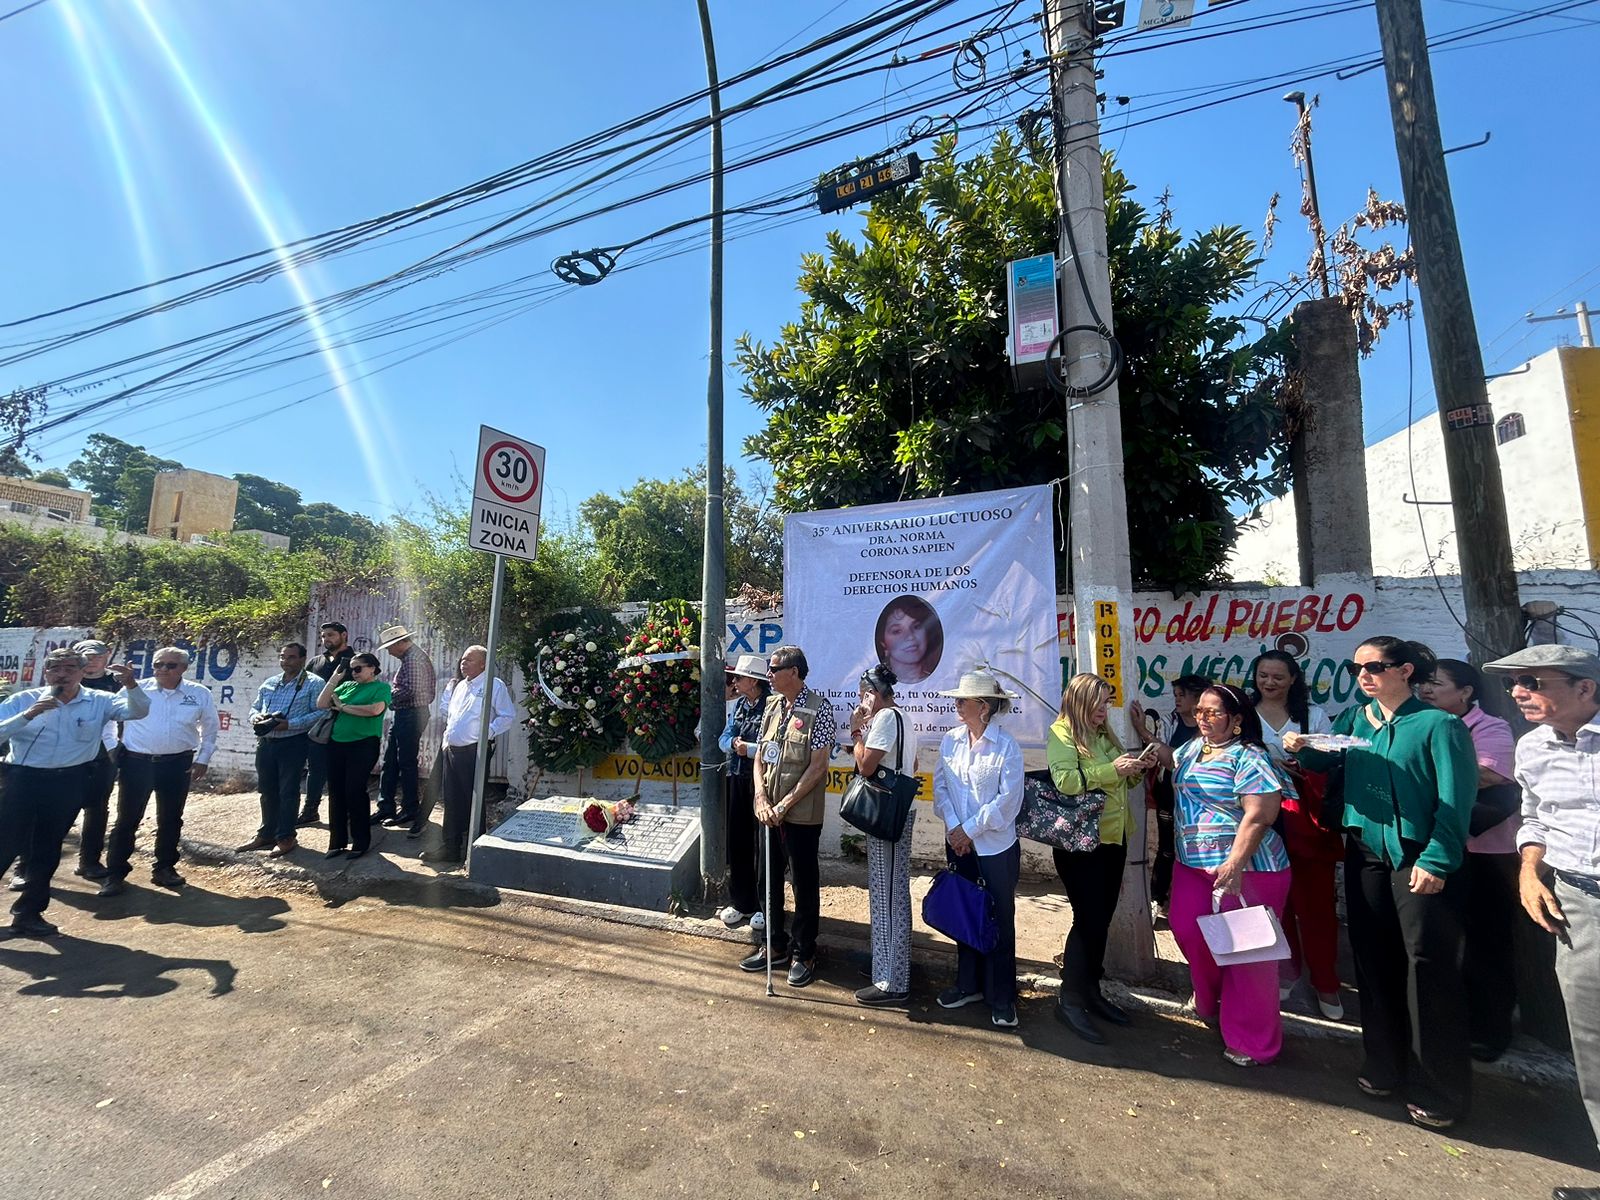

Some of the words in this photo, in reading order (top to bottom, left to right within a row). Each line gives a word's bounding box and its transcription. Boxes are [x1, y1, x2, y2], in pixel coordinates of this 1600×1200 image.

[880, 170, 891, 180] 46
[496, 451, 527, 484] 30
[501, 481, 519, 491] km/h
[481, 509, 530, 534] INICIA
[832, 516, 926, 536] ANIVERSARIO
[929, 507, 1013, 526] LUCTUOSO
[479, 529, 527, 553] ZONA
[869, 535, 897, 545] DRA.
[899, 530, 945, 543] NORMA
[860, 546, 909, 558] CORONA
[912, 542, 955, 555] SAPIEN
[849, 568, 921, 583] DEFENSORA
[925, 567, 942, 578] DE
[945, 565, 970, 577] LOS
[843, 582, 908, 596] DERECHOS
[911, 578, 977, 593] HUMANOS
[1166, 594, 1219, 643] del
[1223, 593, 1364, 642] PUEBLO
[828, 688, 842, 698] luz
[845, 690, 857, 698] no
[908, 690, 918, 699] tu
[926, 702, 956, 715] Sapié
[840, 721, 851, 730] de
[914, 723, 924, 732] 21
[926, 722, 937, 732] de
